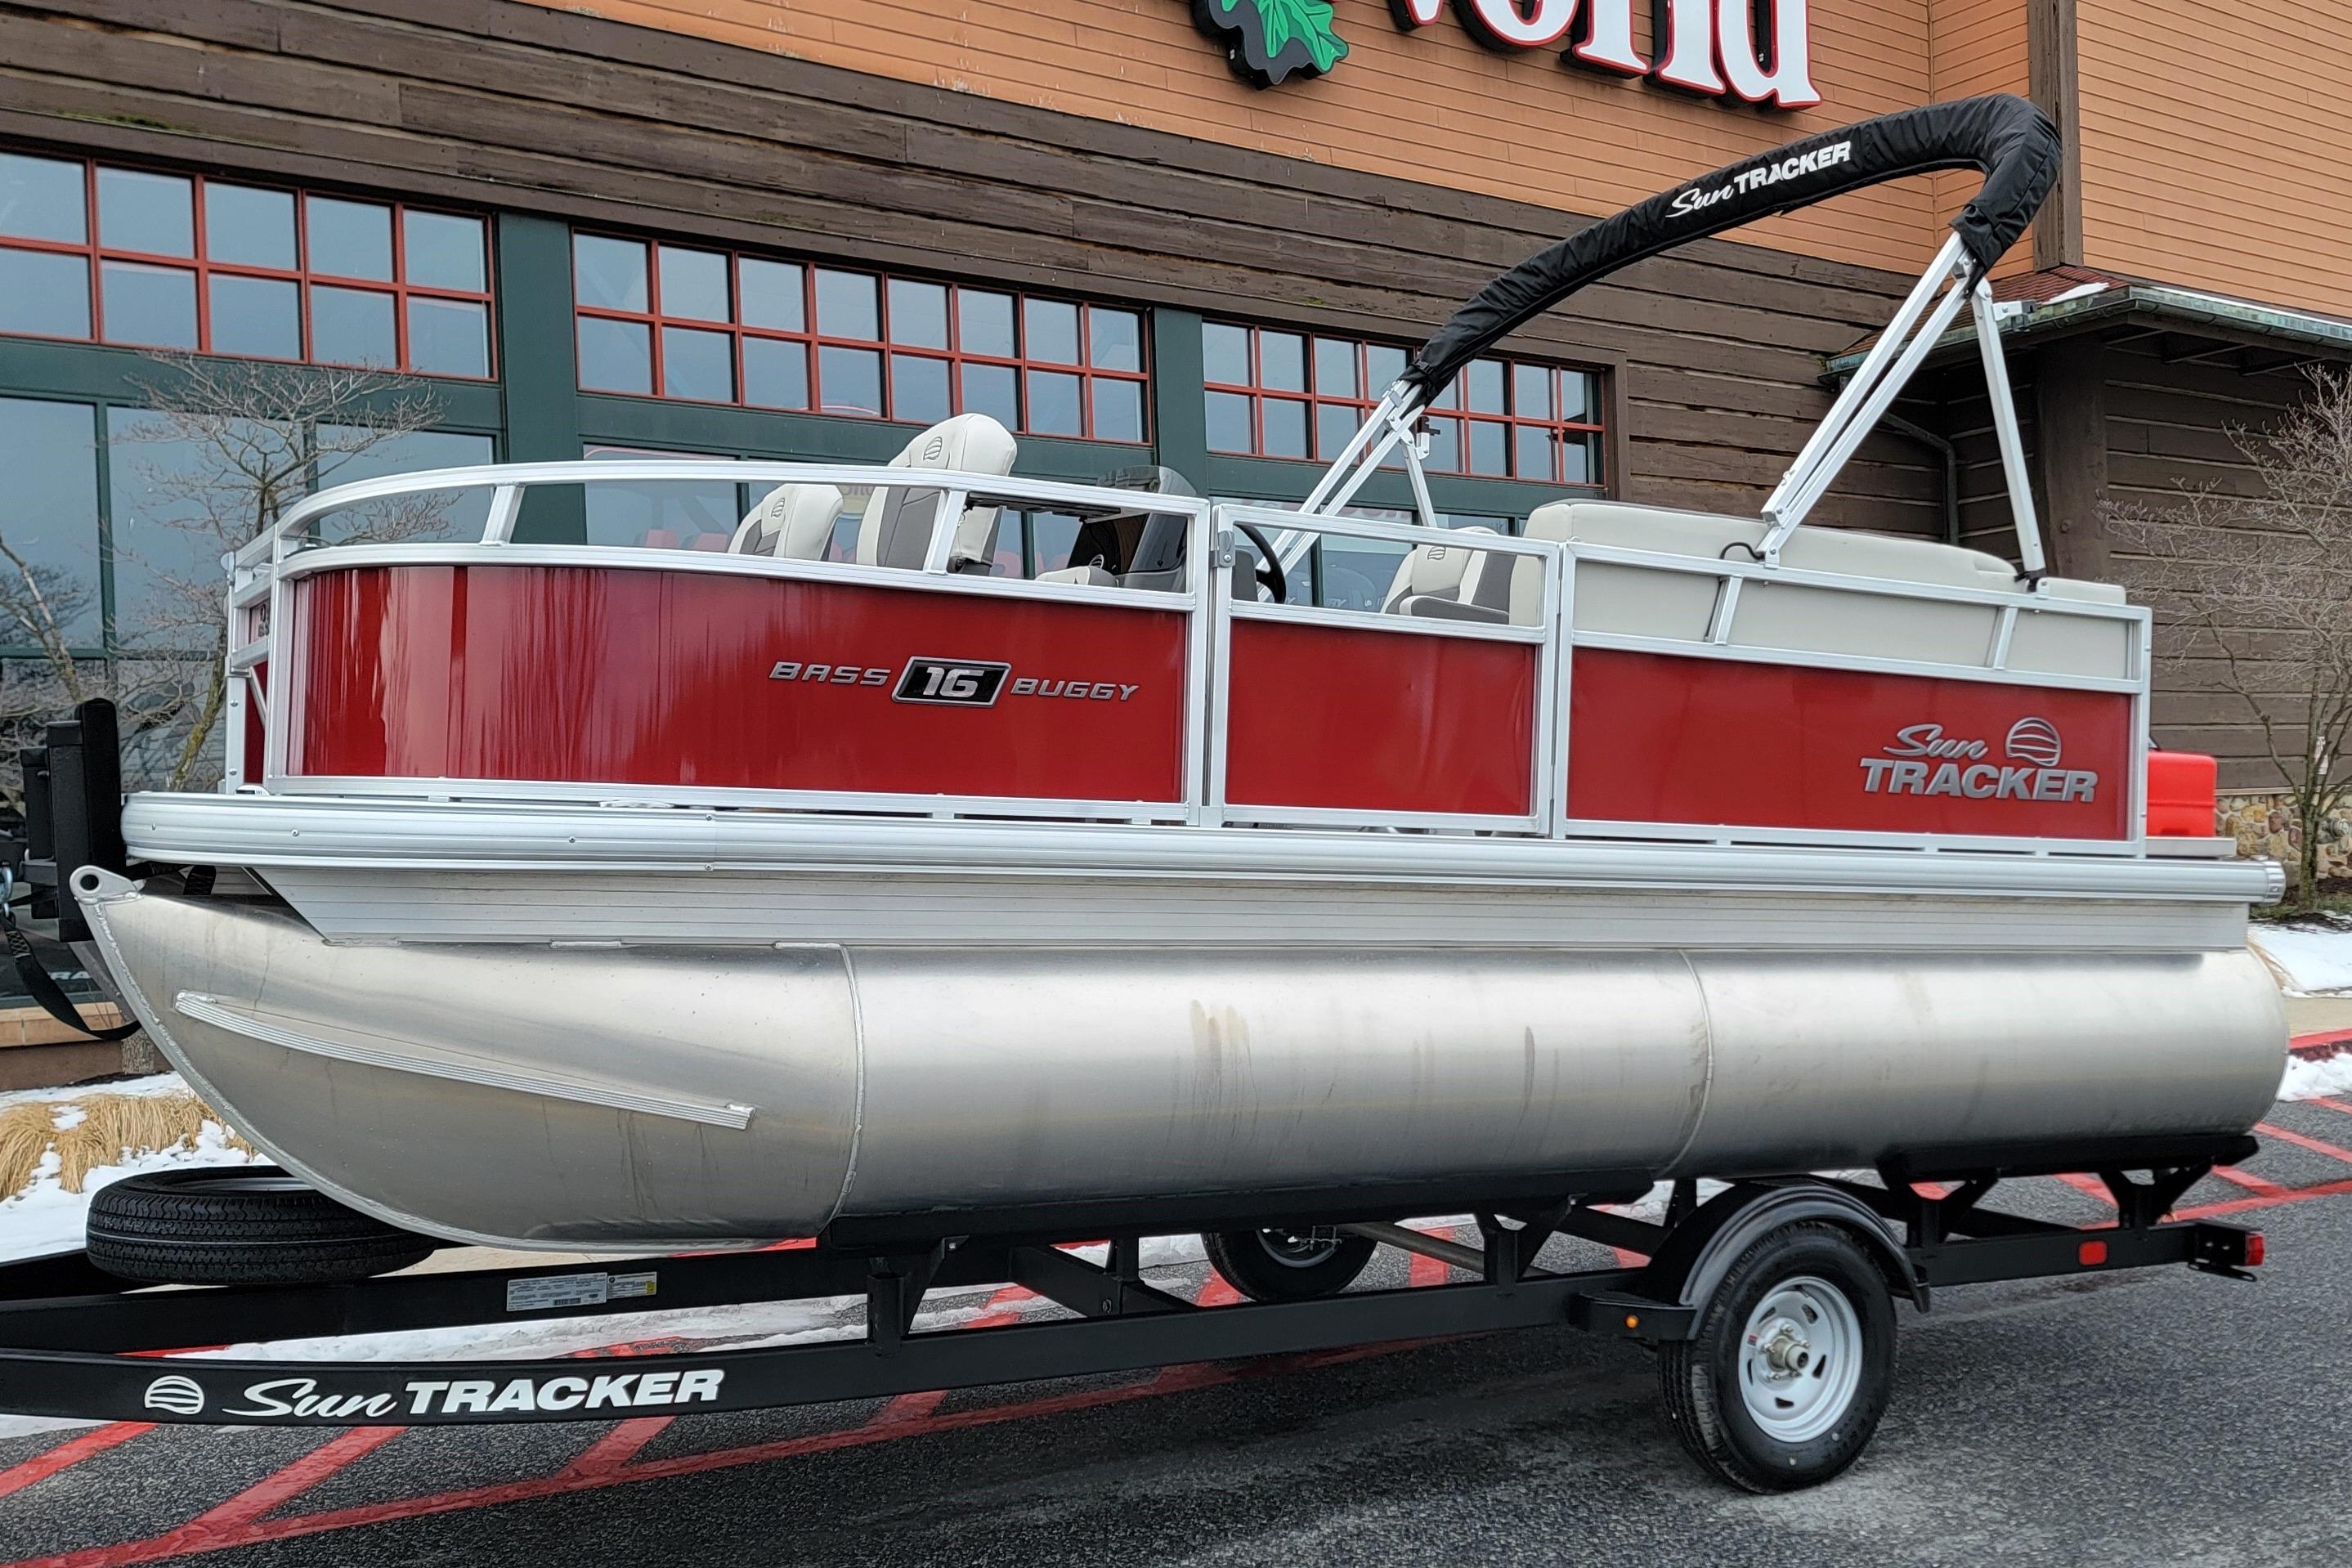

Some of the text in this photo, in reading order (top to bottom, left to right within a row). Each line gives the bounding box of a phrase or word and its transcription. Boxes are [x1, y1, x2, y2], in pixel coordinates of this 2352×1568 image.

[1665, 141, 1851, 217] Sun TRACKER
[768, 661, 1140, 701] BASS 16 BUGGY
[1883, 724, 1989, 759] Sun
[1859, 758, 2099, 802] TRACKER
[222, 1369, 726, 1418] Sun TRACKER
